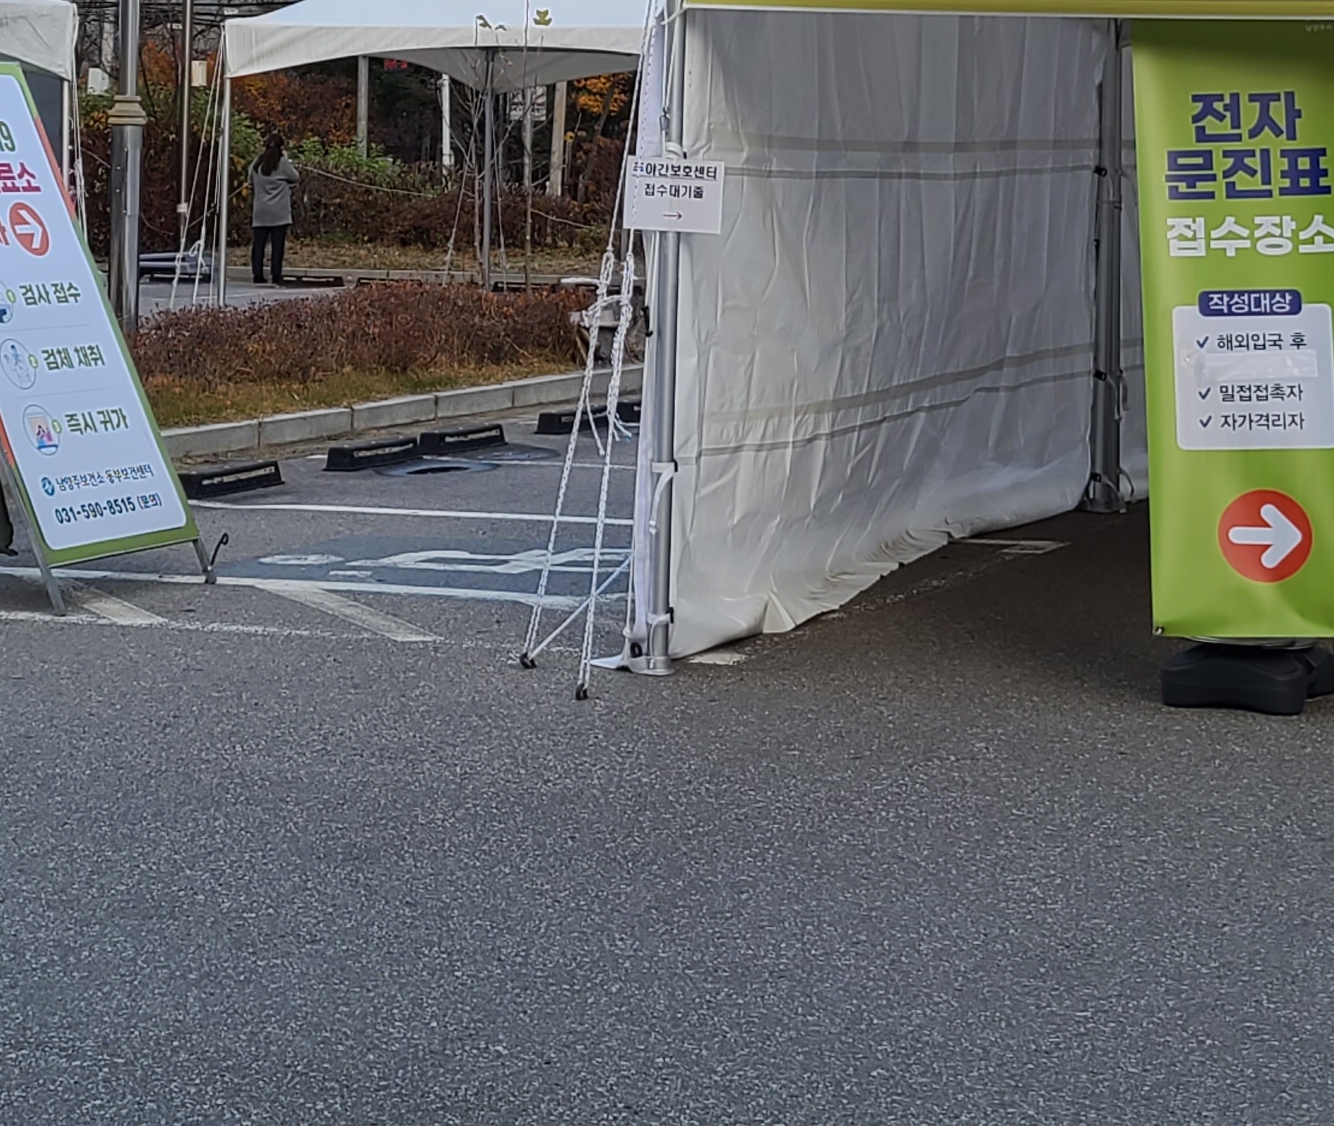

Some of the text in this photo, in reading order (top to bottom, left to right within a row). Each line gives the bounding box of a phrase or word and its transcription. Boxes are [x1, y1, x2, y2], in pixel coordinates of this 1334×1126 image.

[1190, 91, 1302, 143] 전자
[1165, 148, 1332, 200] 문진표
[644, 183, 704, 199] 접수대기줄
[19, 282, 82, 306] 검사 접수
[1208, 293, 1292, 313] 작성대상
[1216, 332, 1307, 351] 해외입국 후
[41, 344, 106, 371] 검체 채취
[1219, 383, 1304, 402] 밀접접촉자
[65, 407, 129, 435] 즉시 귀가
[1220, 412, 1305, 431] 자가격리자
[55, 463, 155, 492] 남양주보건소 동부보건센터
[55, 492, 162, 525] 031-590-8515 (문의)
